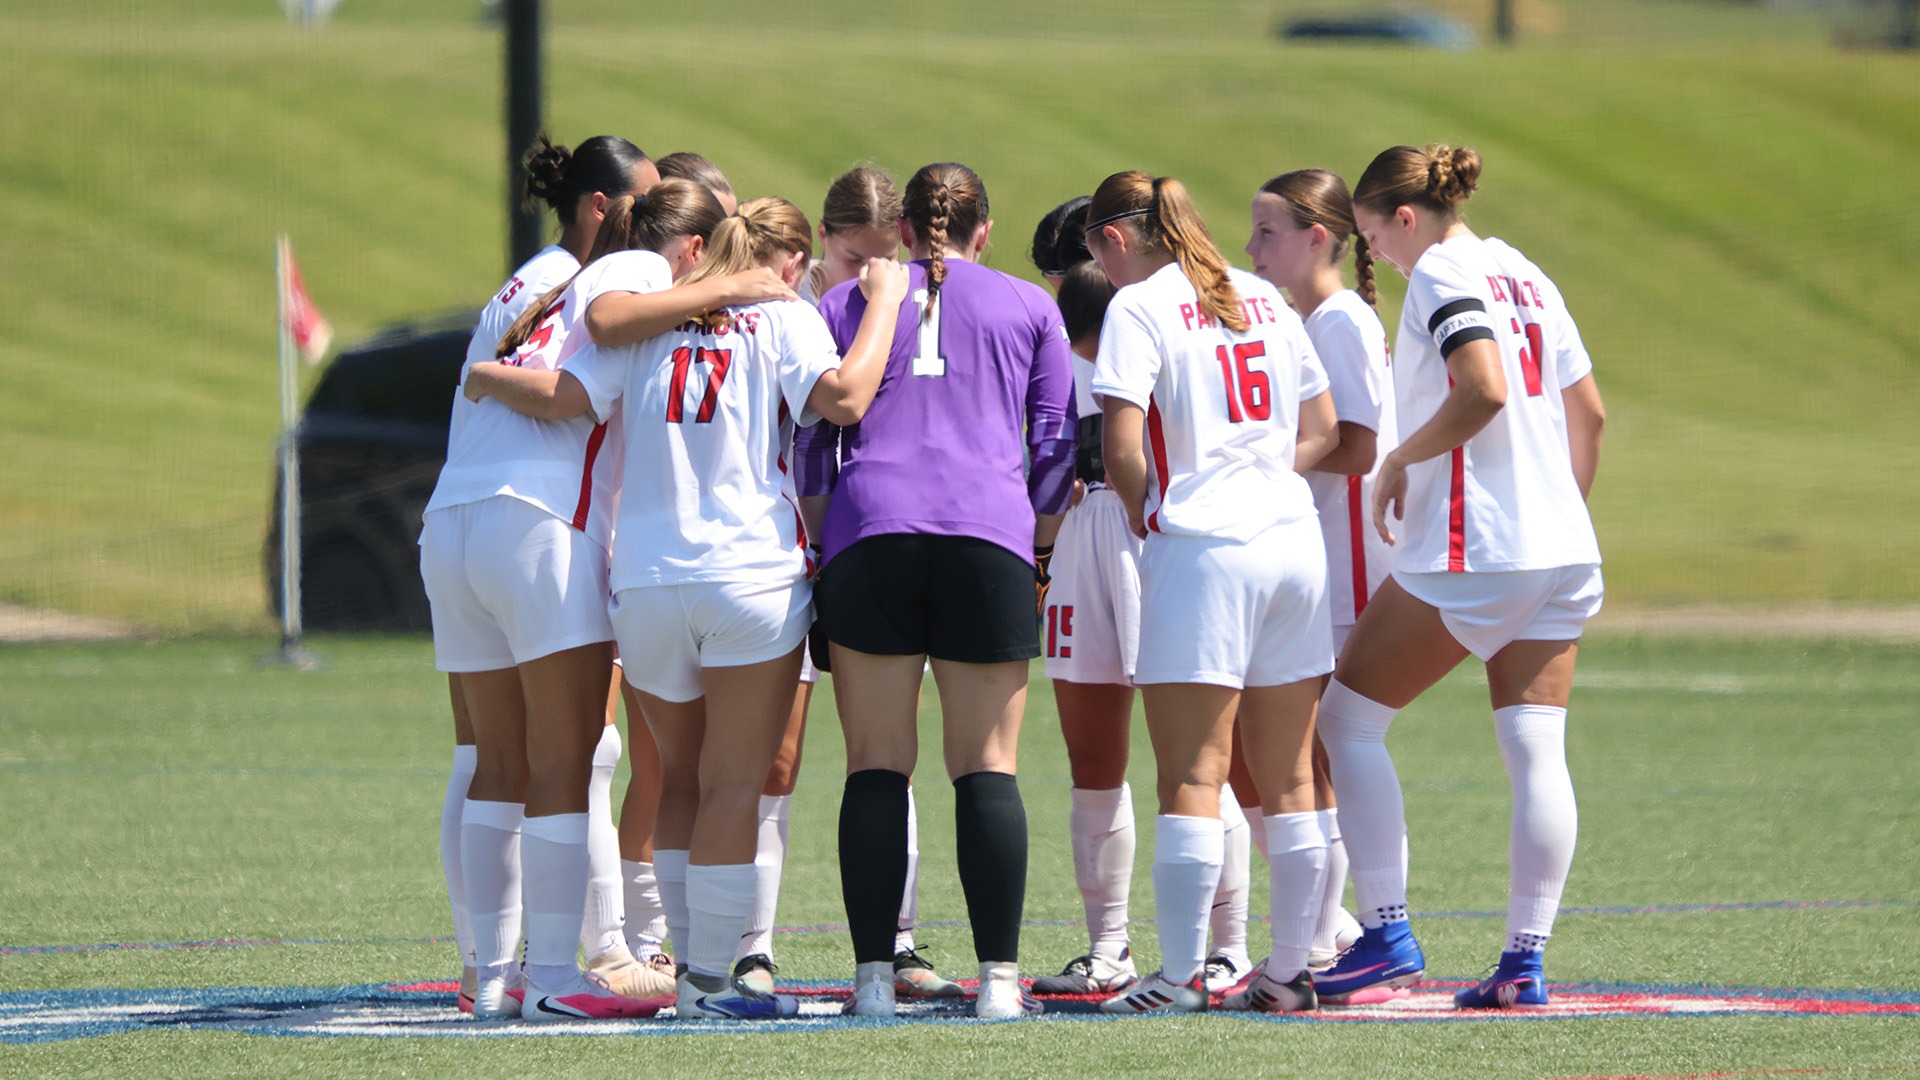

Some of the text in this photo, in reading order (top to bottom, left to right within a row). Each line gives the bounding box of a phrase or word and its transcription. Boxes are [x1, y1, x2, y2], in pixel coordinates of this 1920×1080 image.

[912, 289, 946, 377] 1
[666, 346, 731, 423] 17
[1216, 340, 1271, 423] 16
